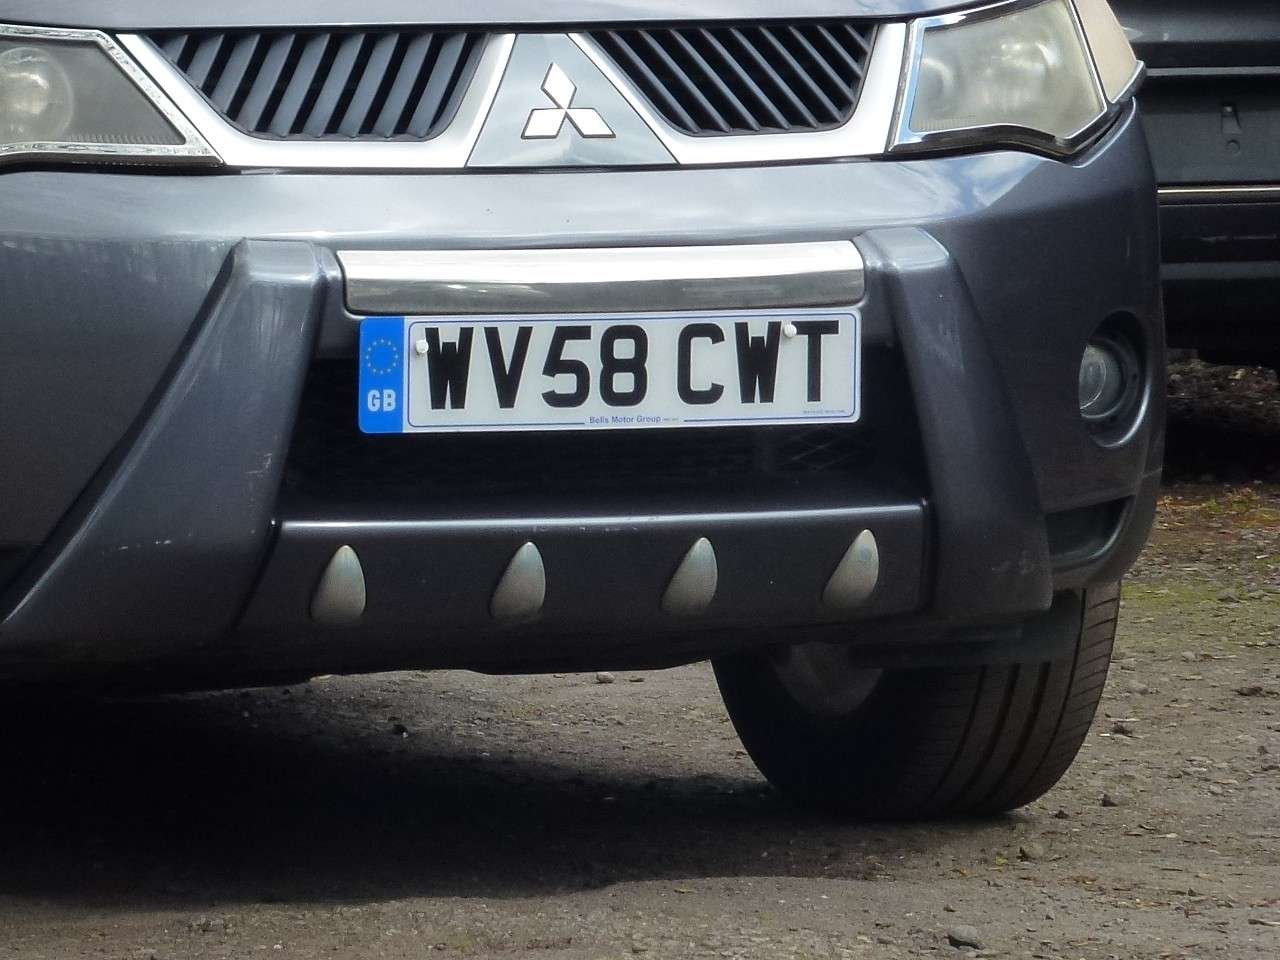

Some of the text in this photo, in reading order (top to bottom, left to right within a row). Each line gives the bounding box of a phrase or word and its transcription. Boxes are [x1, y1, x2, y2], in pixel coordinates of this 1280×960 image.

[424, 319, 840, 410] WV58 CWT
[367, 389, 396, 412] GB
[611, 415, 634, 424] Motor
[636, 415, 662, 424] Group
